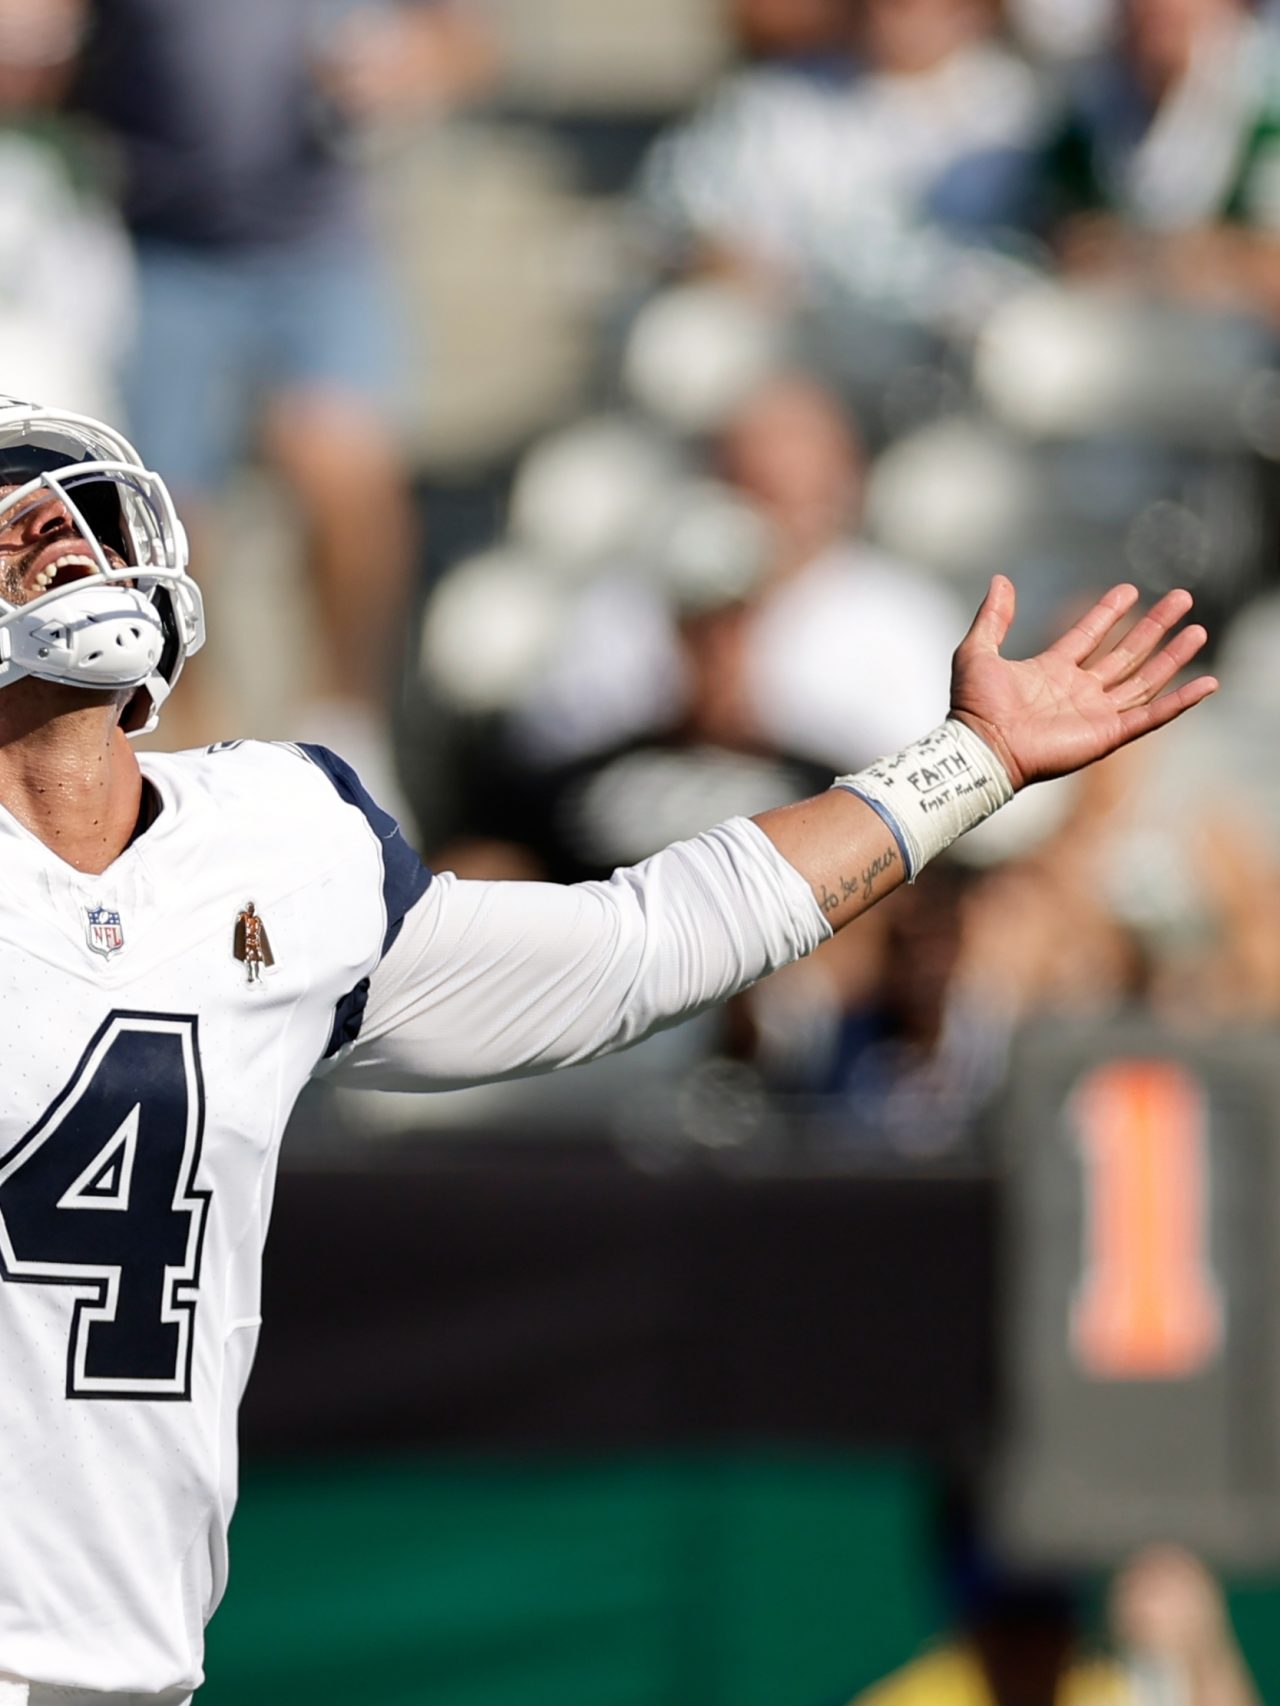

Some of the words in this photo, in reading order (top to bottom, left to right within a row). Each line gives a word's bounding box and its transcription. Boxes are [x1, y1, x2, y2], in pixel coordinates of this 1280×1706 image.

[907, 751, 967, 790] FAITH
[819, 884, 839, 912] to
[840, 876, 858, 902] be
[93, 926, 122, 949] NFL
